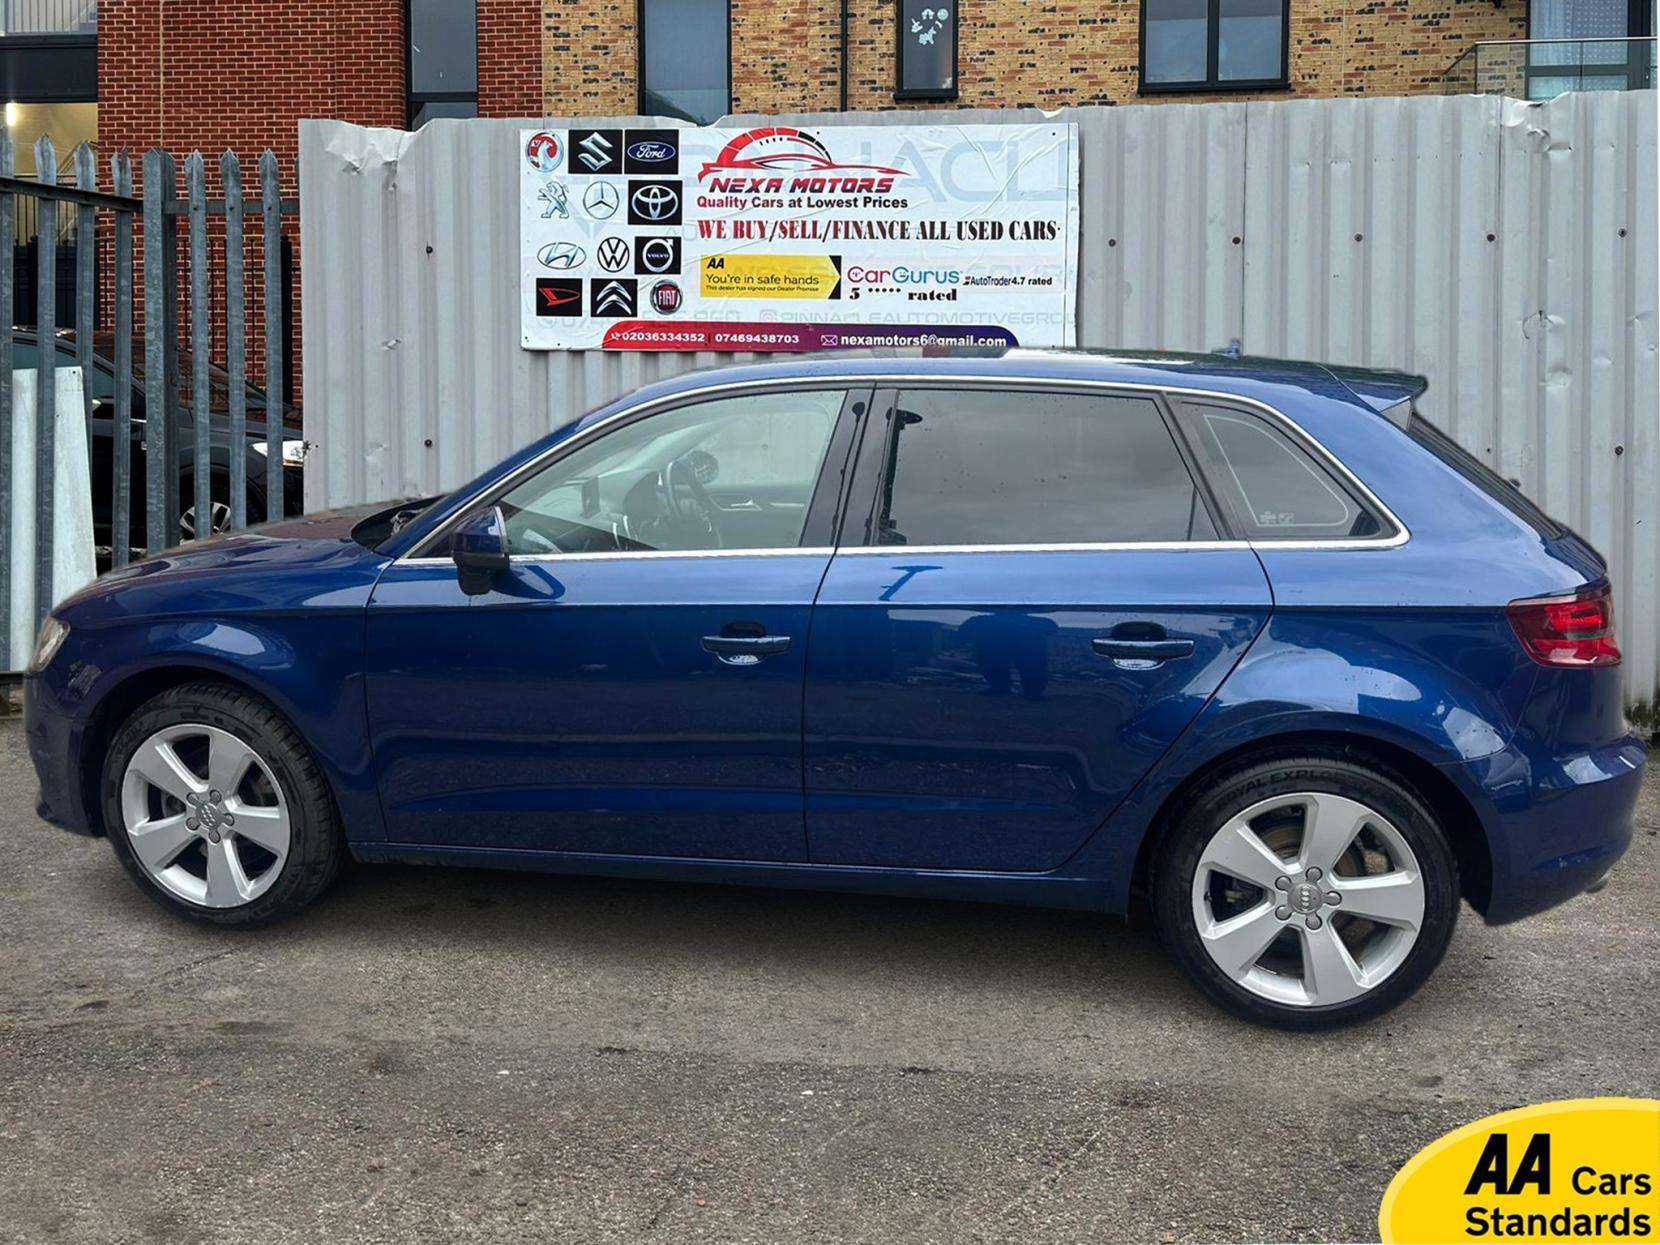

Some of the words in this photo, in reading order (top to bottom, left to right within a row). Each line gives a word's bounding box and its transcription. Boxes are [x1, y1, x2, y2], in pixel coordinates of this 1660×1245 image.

[636, 144, 666, 158] Ford
[709, 177, 783, 194] NEXA
[789, 177, 894, 194] MOTORS
[697, 196, 747, 210] Quality
[752, 196, 784, 209] Cars
[788, 197, 803, 209] at
[807, 196, 859, 209] Lowest
[863, 196, 908, 209] Prices
[697, 220, 727, 240] WE
[916, 220, 950, 241] ALL
[956, 220, 1004, 241] USED
[707, 257, 725, 269] AA
[705, 274, 741, 284] You're
[744, 275, 754, 284] in
[757, 274, 781, 285] safe
[784, 275, 820, 285] hands
[847, 266, 960, 284] CarGurus
[1028, 277, 1053, 286] rated
[658, 290, 676, 305] FIAT
[849, 287, 860, 300] 5
[908, 288, 957, 301] rated
[622, 332, 705, 342] 02036334352
[715, 334, 799, 344] 07469438703
